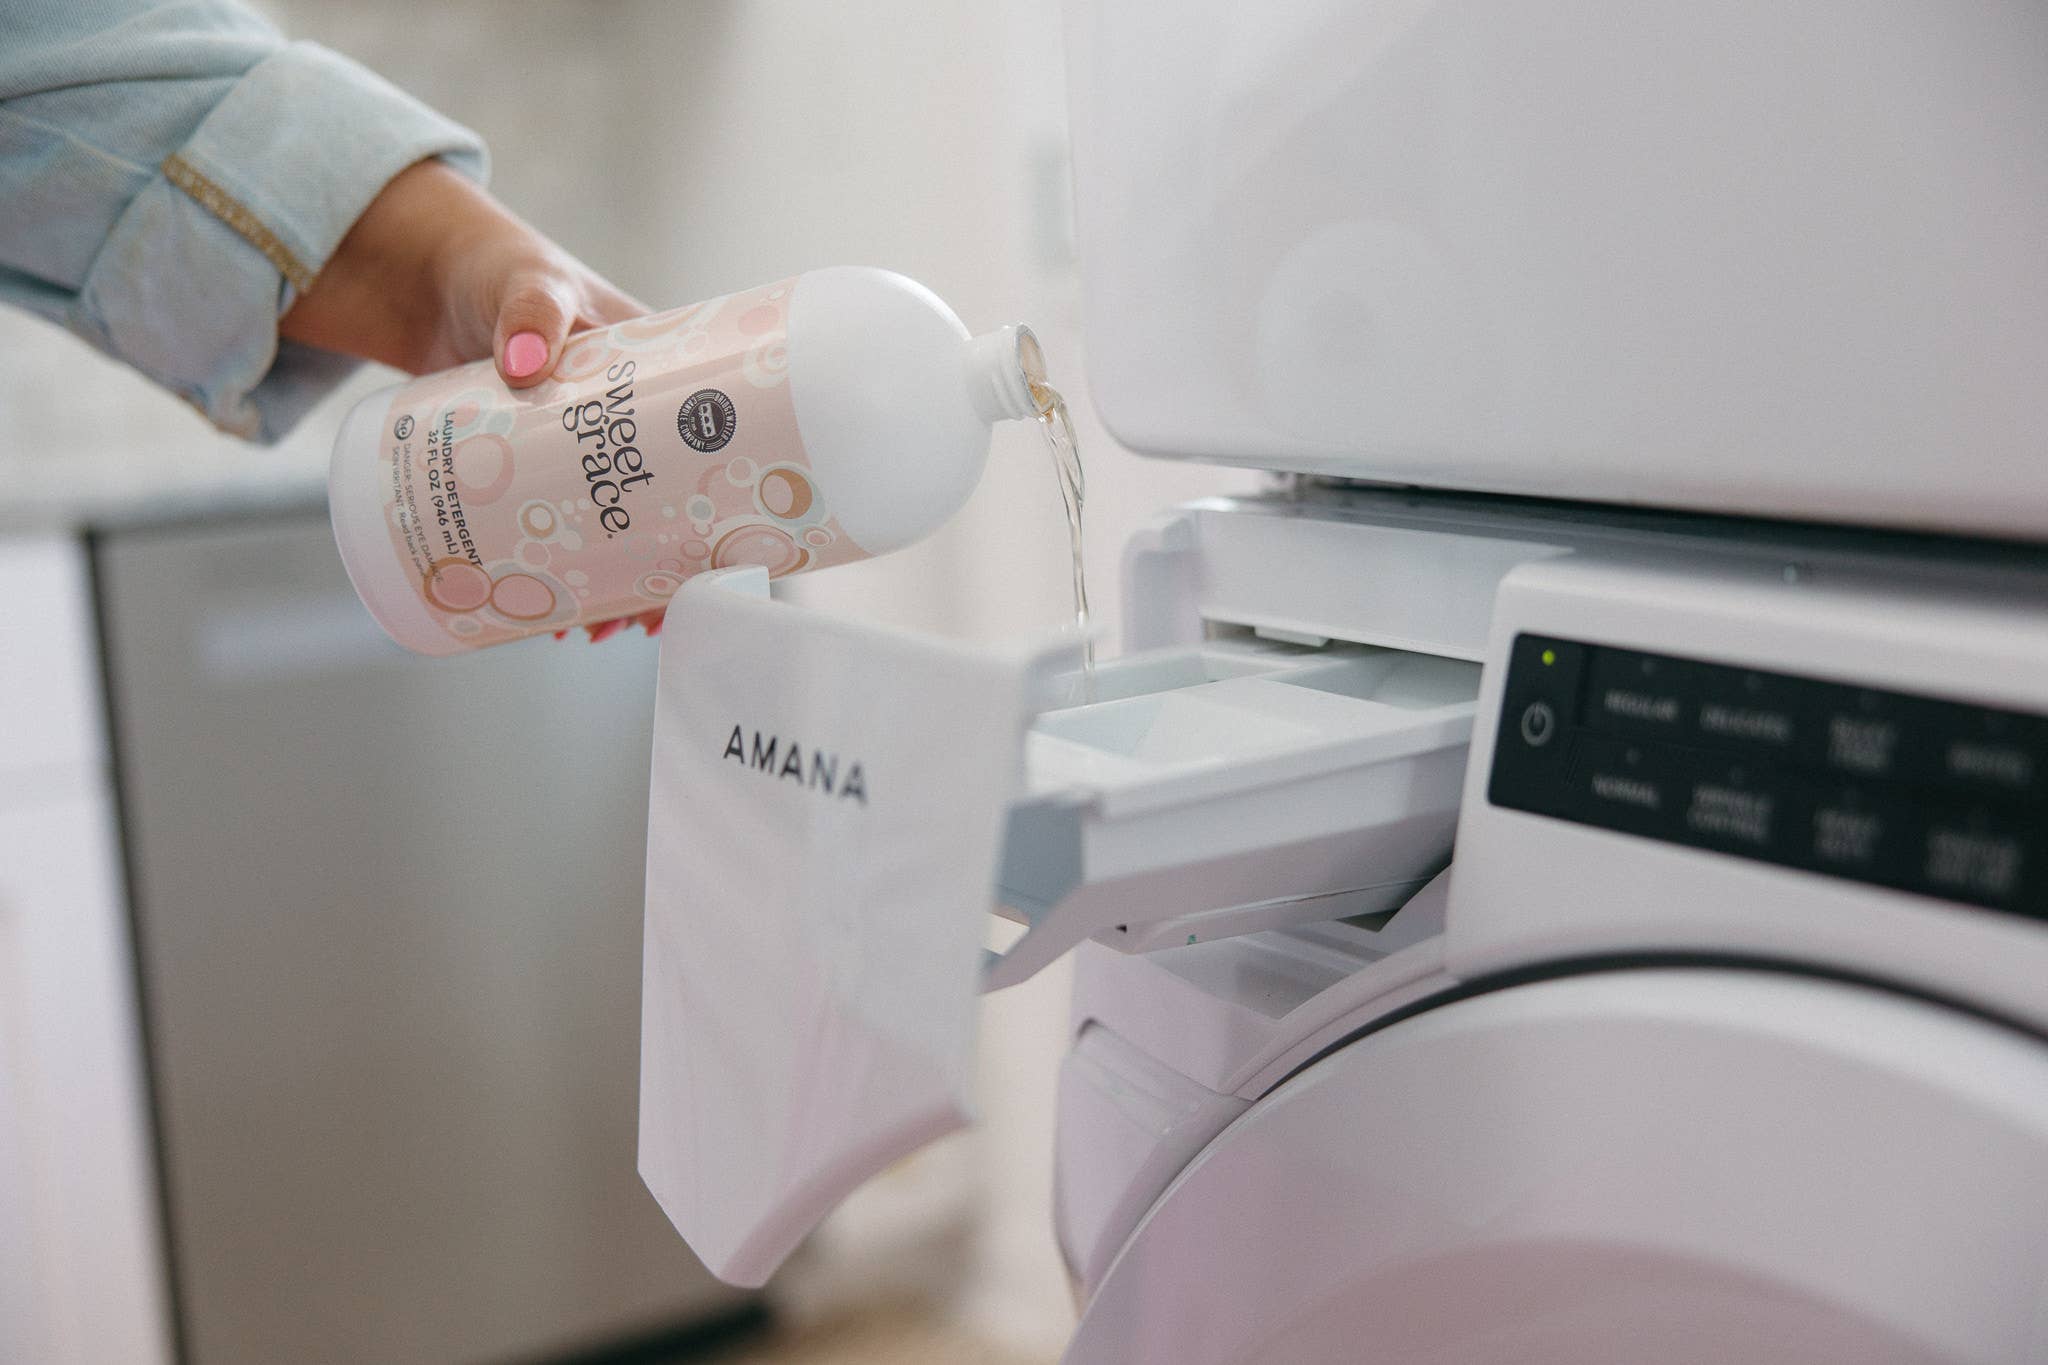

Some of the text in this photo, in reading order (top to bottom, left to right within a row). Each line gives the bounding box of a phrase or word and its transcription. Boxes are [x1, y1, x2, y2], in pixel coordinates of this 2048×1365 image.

[607, 360, 654, 492] sweet
[680, 396, 706, 450] CANDLE COMPANY
[714, 392, 734, 441] BRIDGEWATER
[405, 484, 420, 524] SERIOUS
[415, 525, 426, 543] EYE
[427, 430, 460, 555] 32 FL OZ (946 mL)
[442, 411, 483, 567] LAUNDRY DETERGENT
[723, 723, 868, 806] AMANA
